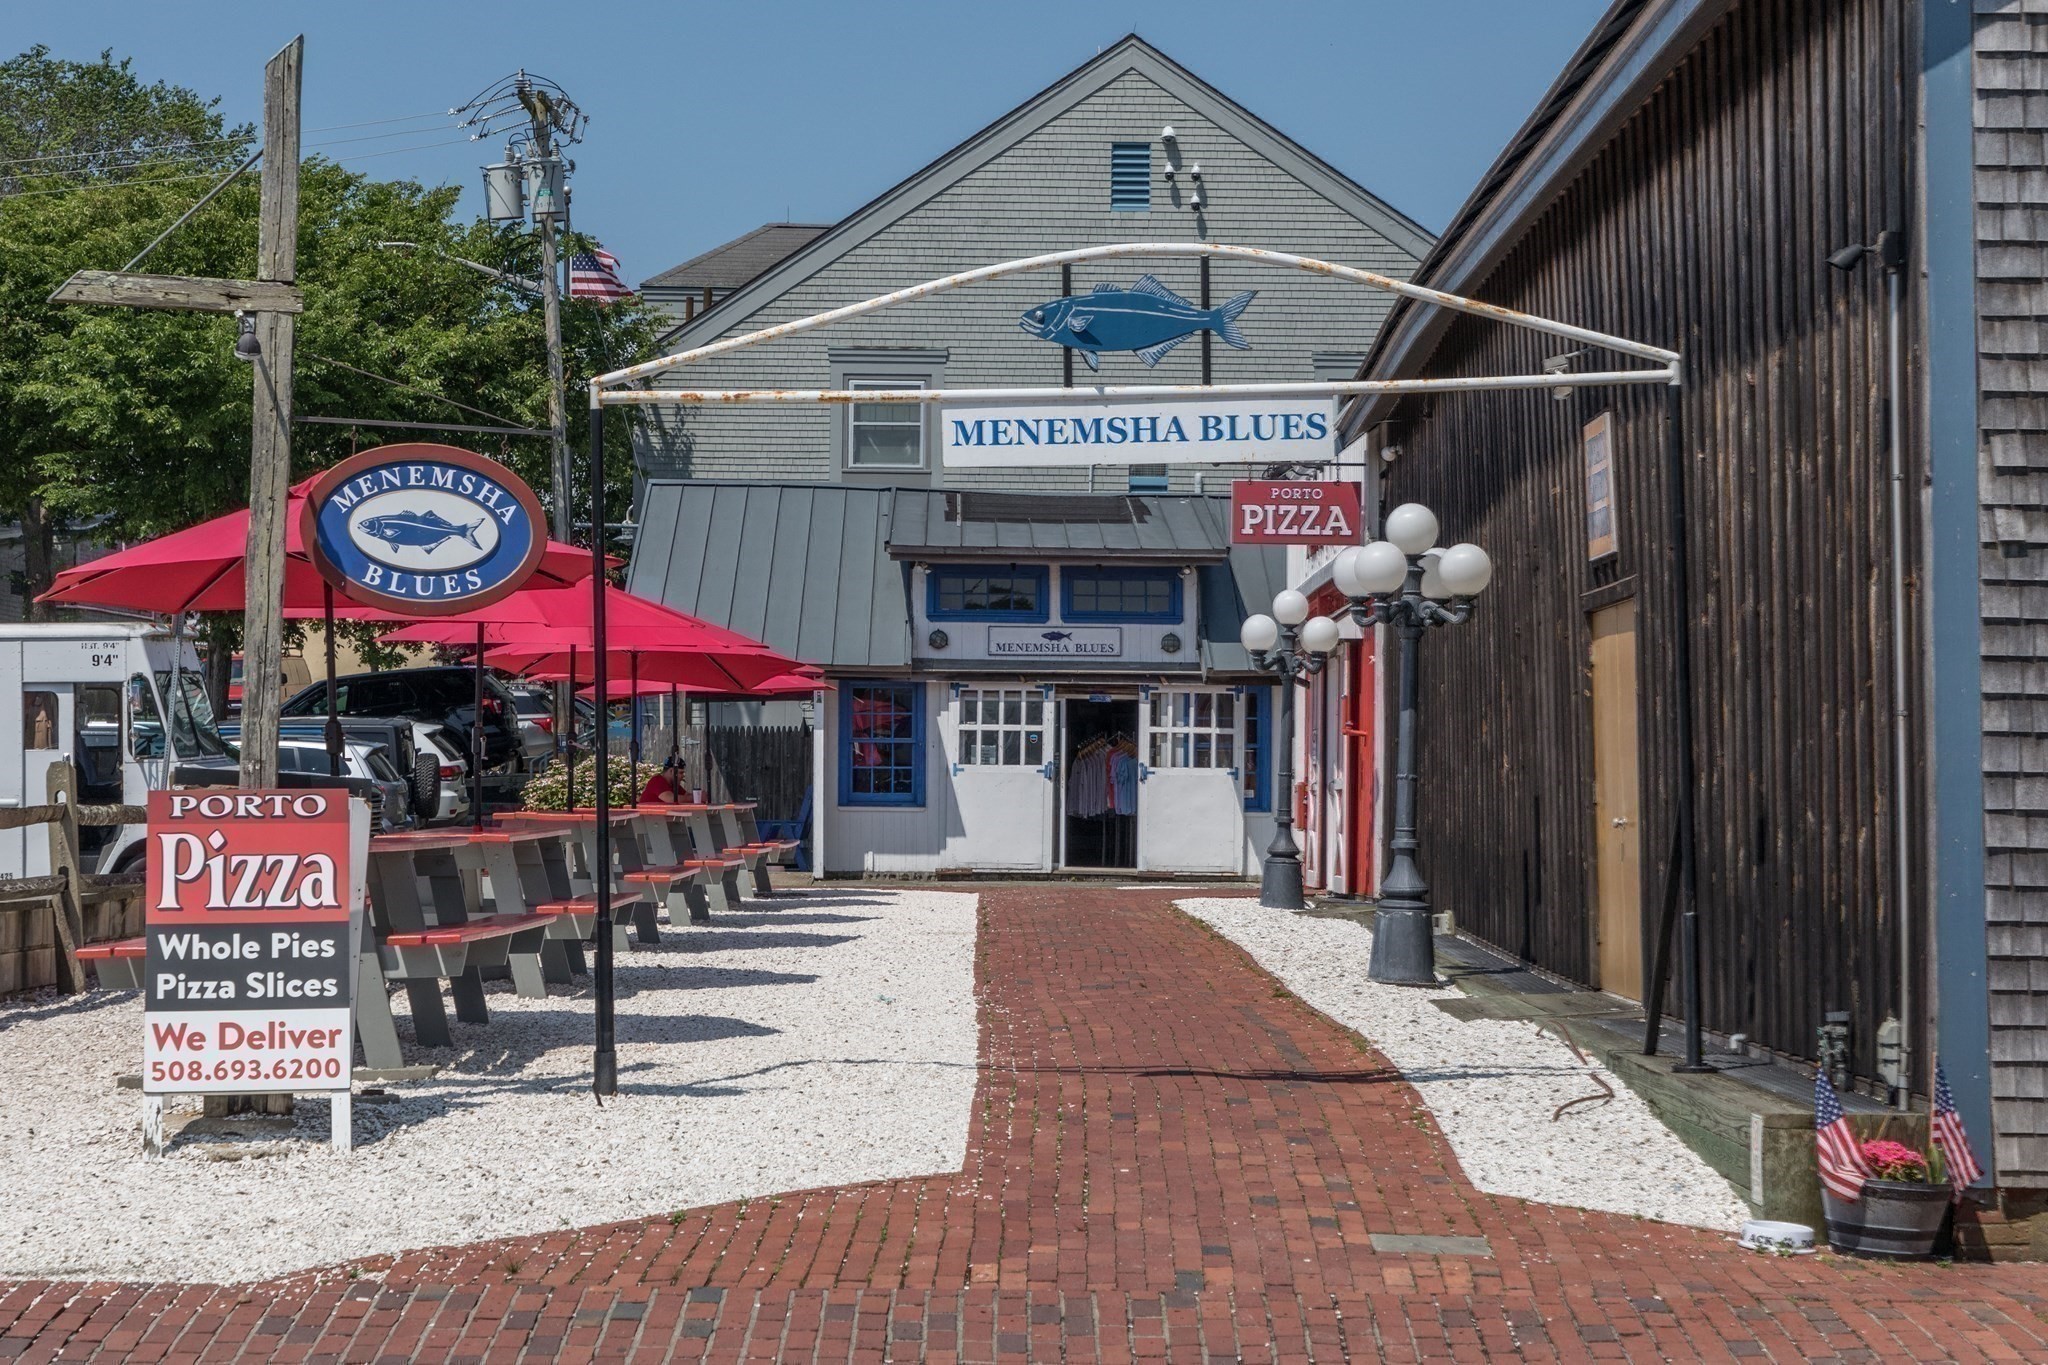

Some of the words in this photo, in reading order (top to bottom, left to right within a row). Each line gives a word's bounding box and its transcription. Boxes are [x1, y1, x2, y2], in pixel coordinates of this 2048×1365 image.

[951, 415, 1190, 447] MENEMSHA
[1198, 412, 1328, 443] BLUES
[331, 466, 517, 526] MENEMSHA
[1270, 487, 1323, 500] PORTO
[1241, 504, 1353, 536] PIZZA
[362, 563, 482, 596] BLUES
[92, 654, 118, 667] 9'4"
[995, 643, 1069, 653] MENEMSHA
[1075, 643, 1114, 653] BLUES
[170, 795, 327, 819] PORTO
[156, 829, 342, 911] Pizza
[158, 933, 260, 961] Whole
[271, 932, 335, 959] Pies
[156, 973, 235, 1000] Pizza
[246, 971, 338, 999] Slices
[152, 1022, 206, 1052] We
[218, 1020, 342, 1051] Deliver
[151, 1057, 341, 1082] 508.693.6200
